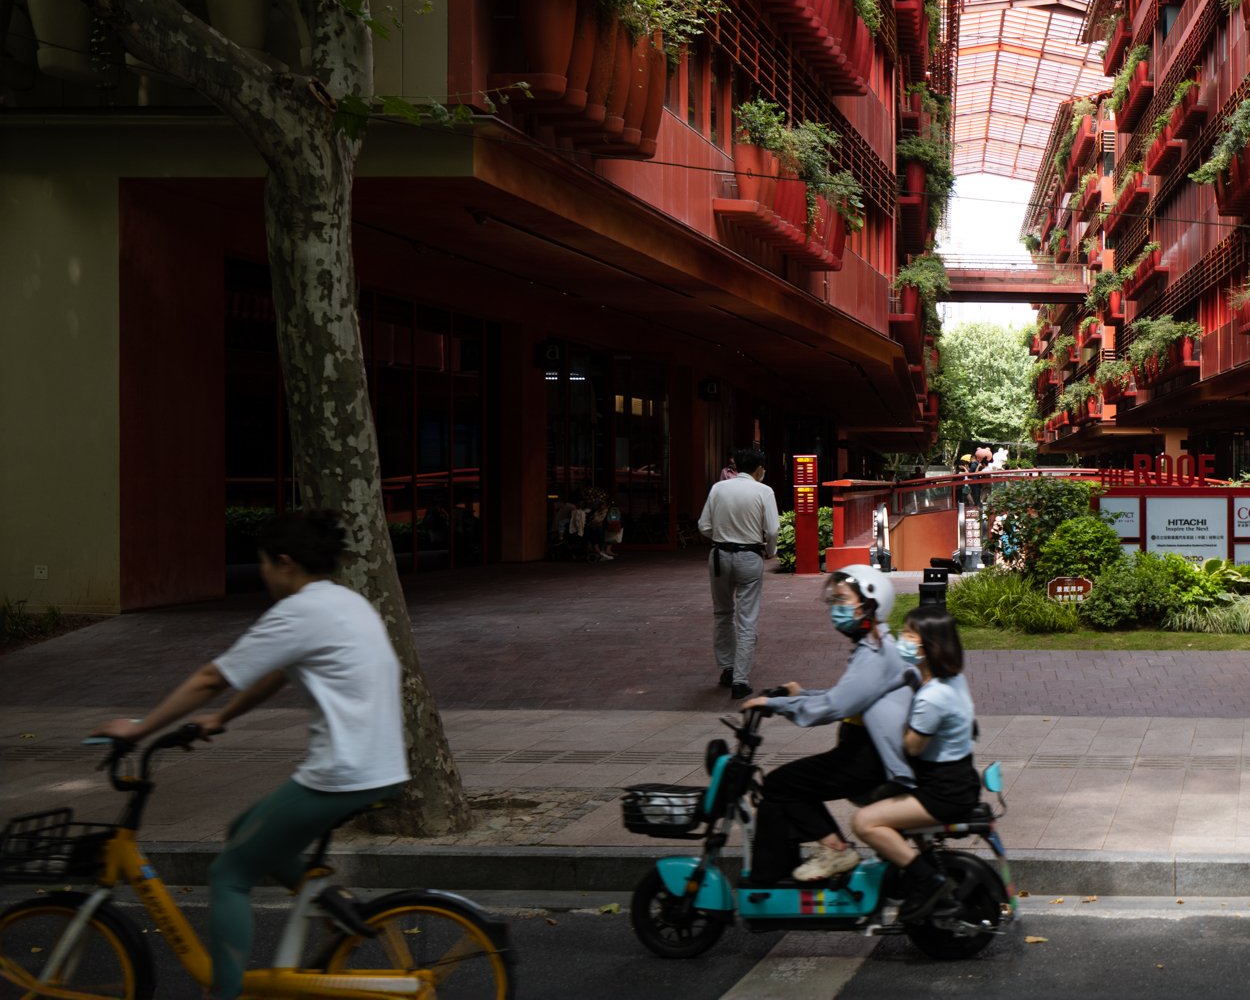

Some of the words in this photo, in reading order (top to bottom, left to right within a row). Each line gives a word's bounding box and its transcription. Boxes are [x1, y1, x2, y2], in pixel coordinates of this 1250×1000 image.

[1098, 469, 1131, 487] THE
[1133, 453, 1216, 487] ROOF
[1168, 518, 1207, 526] HITACHI
